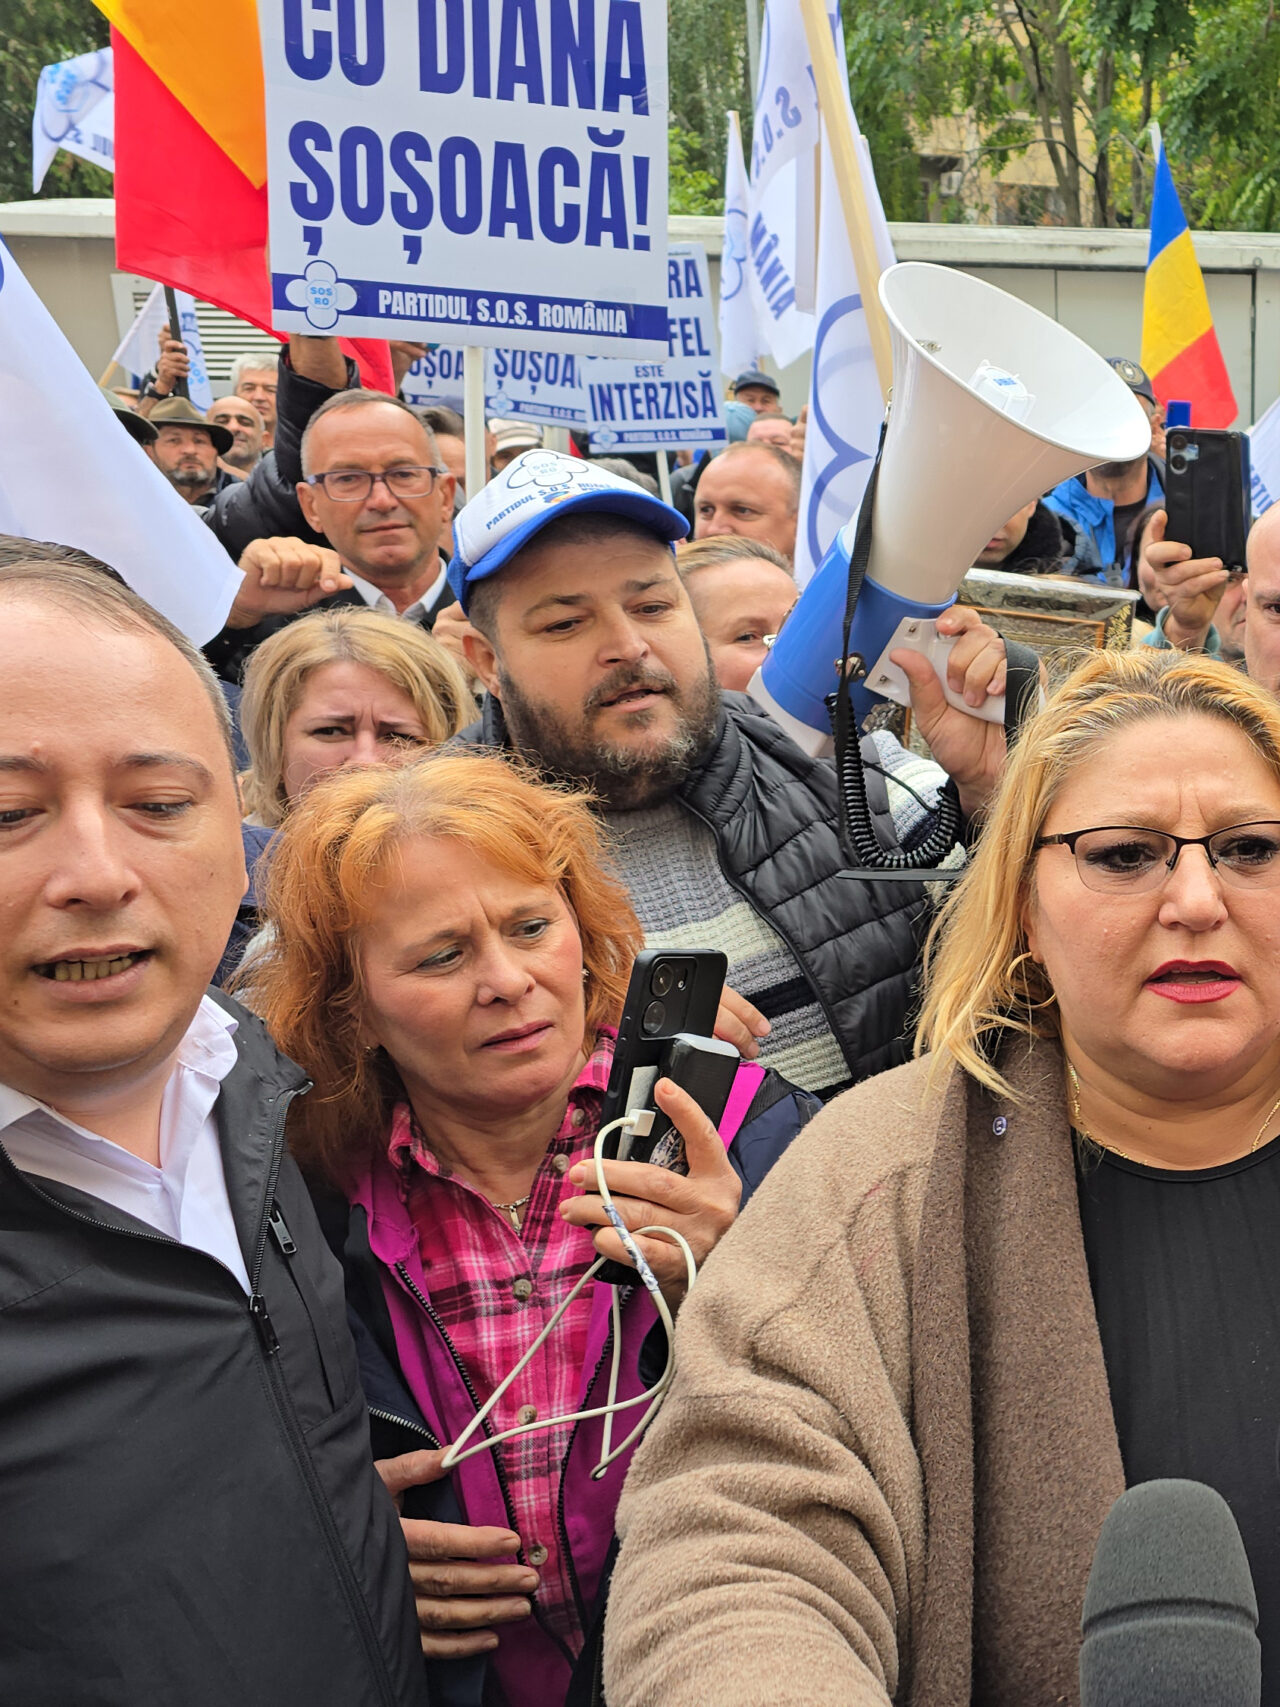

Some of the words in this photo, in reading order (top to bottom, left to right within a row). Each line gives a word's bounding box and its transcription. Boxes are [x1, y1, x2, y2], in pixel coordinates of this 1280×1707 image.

[284, 0, 386, 87] CU
[419, 0, 651, 117] DIANA
[288, 120, 651, 265] ȘOȘOACĂ!
[310, 287, 333, 296] SOS
[378, 289, 472, 321] PARTIDUL
[477, 299, 533, 327] S.O.S.
[538, 302, 628, 334] ROMÂNIA
[635, 365, 664, 378] ESTE
[589, 370, 718, 422] INTERZISĂ
